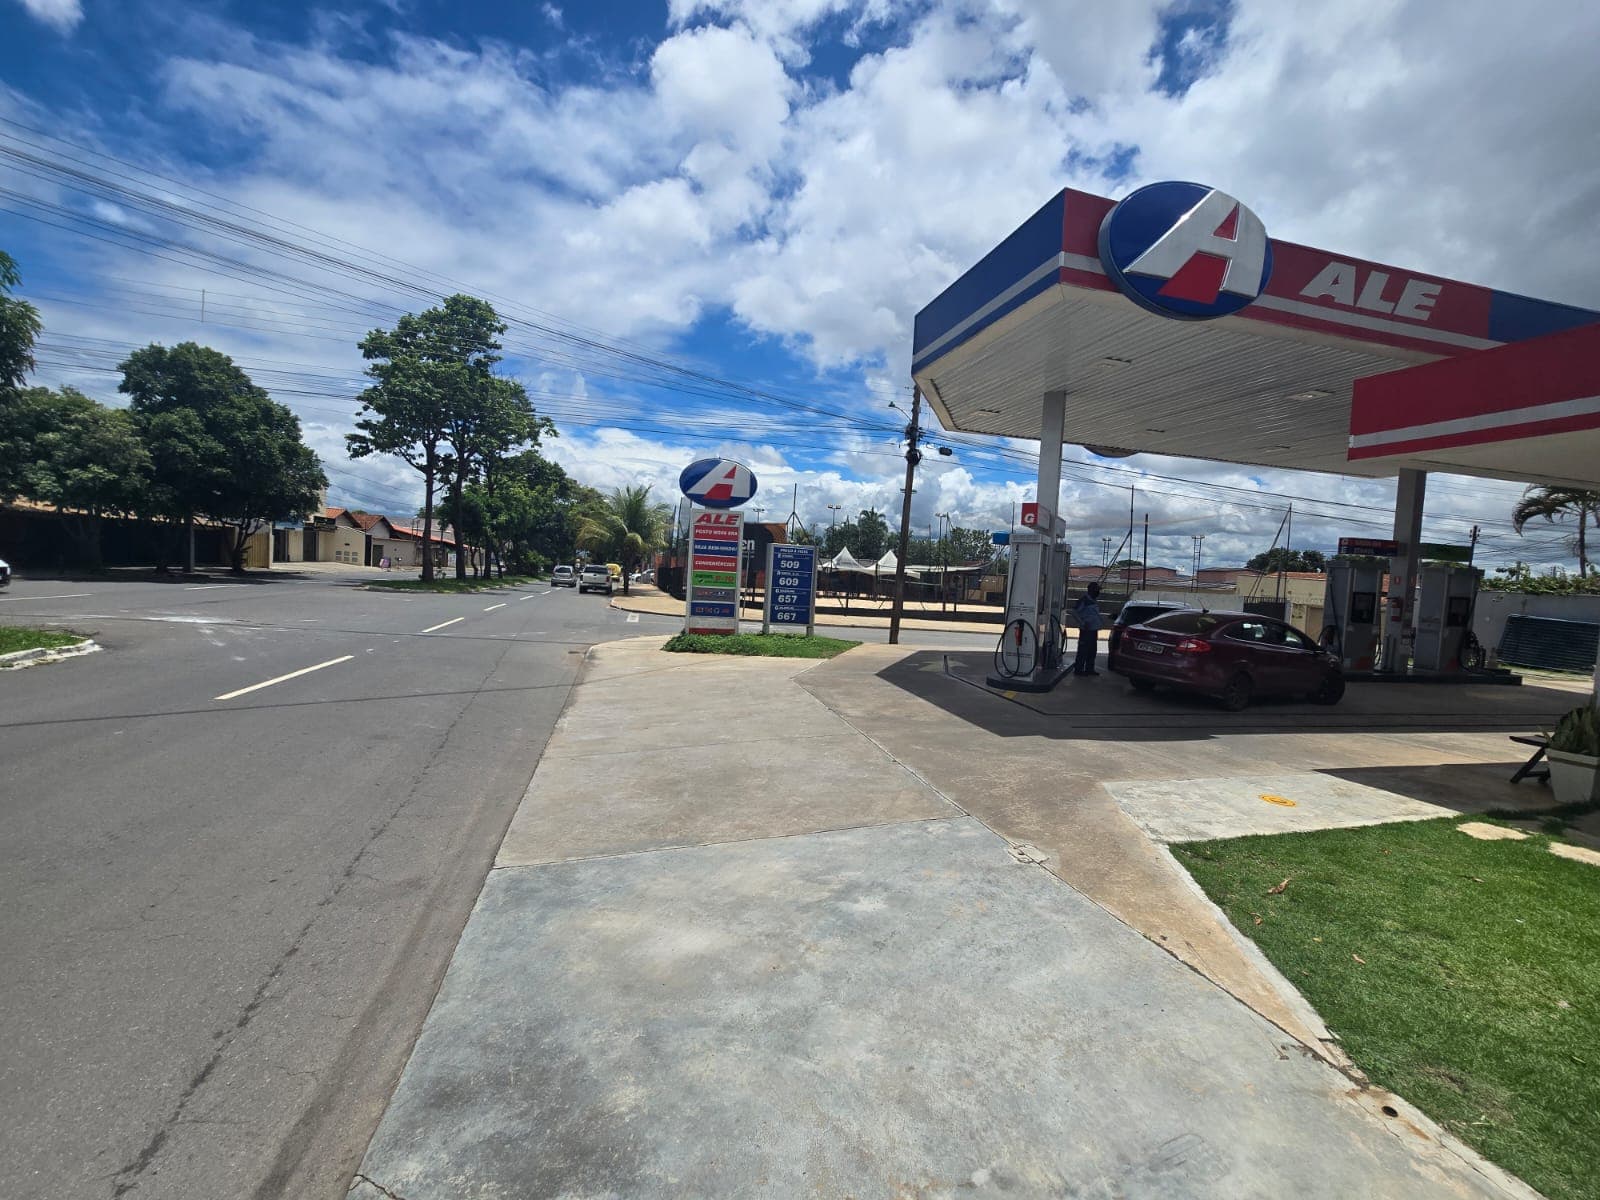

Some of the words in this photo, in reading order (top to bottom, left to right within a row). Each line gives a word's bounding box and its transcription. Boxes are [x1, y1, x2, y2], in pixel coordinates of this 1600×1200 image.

[1122, 189, 1266, 298] A
[1299, 260, 1442, 321] ALE
[687, 460, 750, 498] A
[696, 512, 740, 525] ALE
[1024, 513, 1035, 523] G
[780, 560, 800, 569] 509
[779, 577, 799, 586] 609
[778, 594, 797, 604] 657
[777, 612, 797, 621] 667
